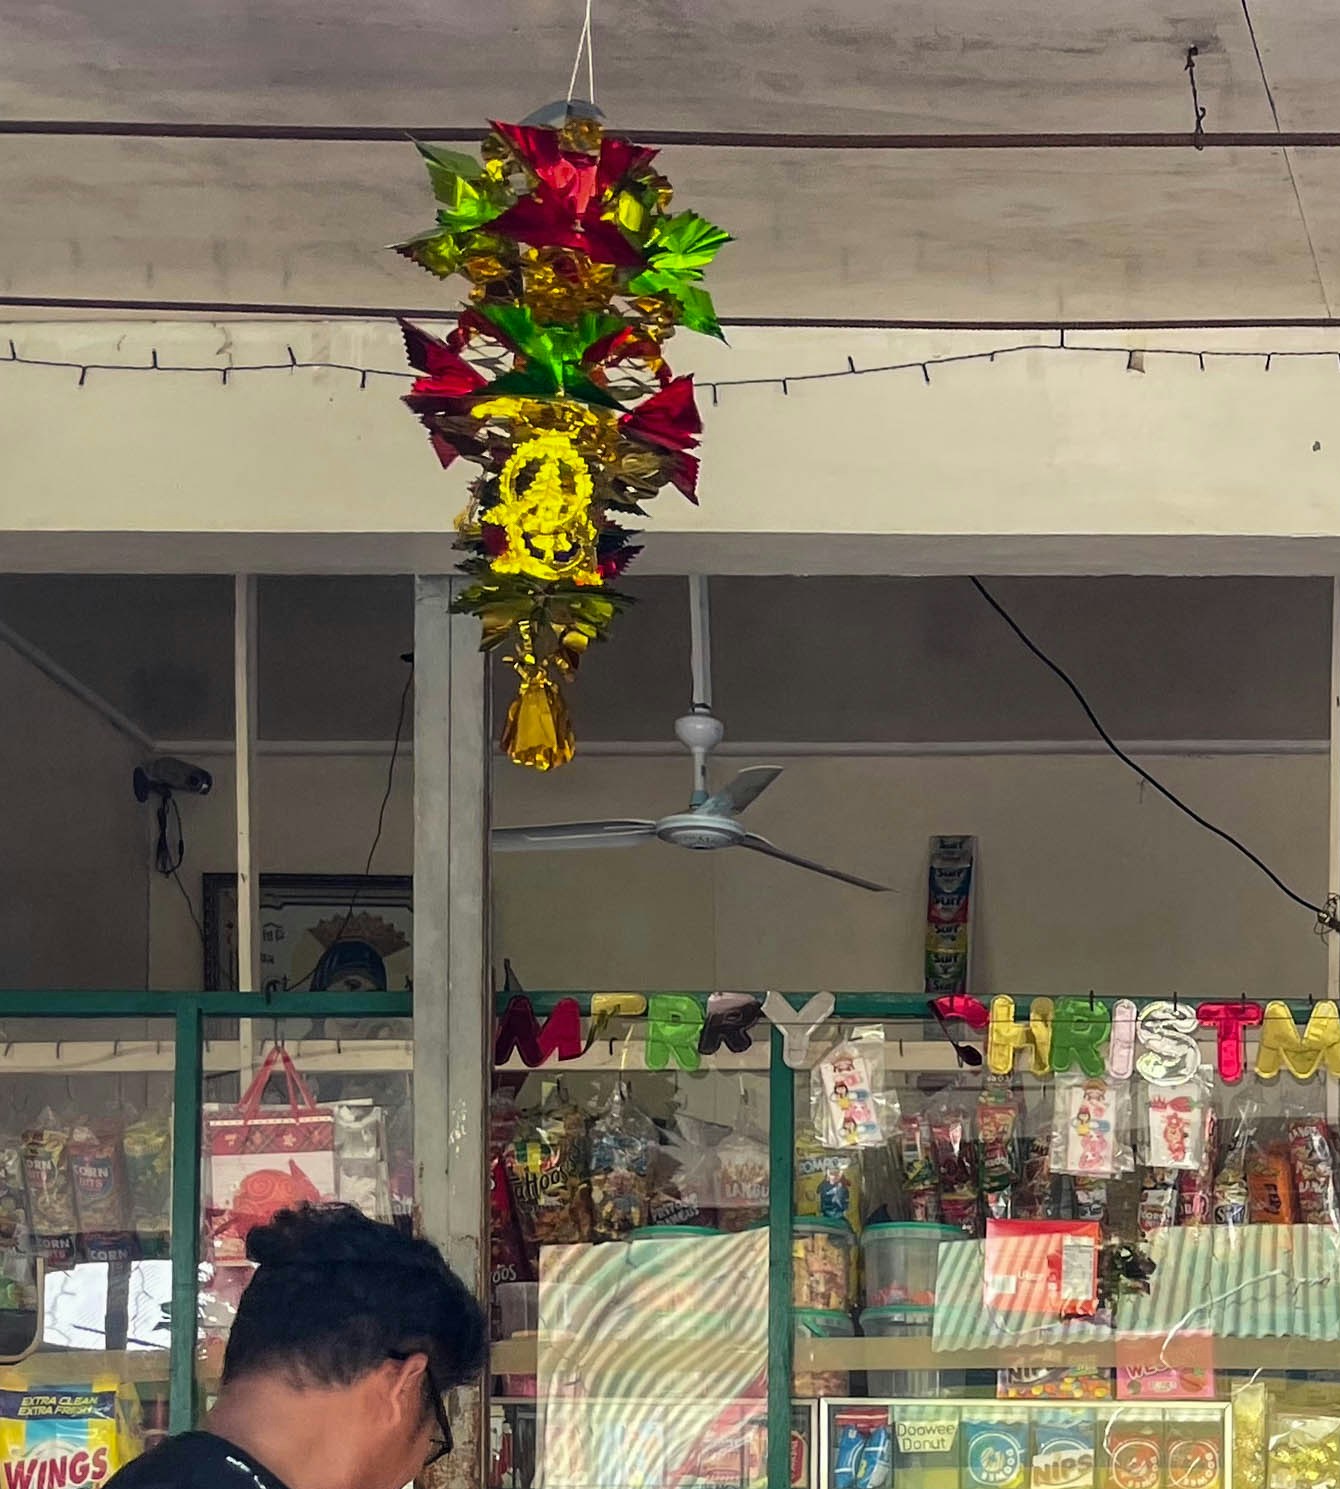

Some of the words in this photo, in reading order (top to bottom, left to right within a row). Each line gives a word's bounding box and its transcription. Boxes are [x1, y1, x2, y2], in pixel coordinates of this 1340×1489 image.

[21, 1396, 57, 1406] EXTRA
[58, 1396, 98, 1405] CLEAN
[18, 1406, 53, 1416] EXTRA
[896, 1423, 955, 1436] Doowee
[901, 1437, 946, 1450] Donut
[1032, 1453, 1093, 1486] NIPS
